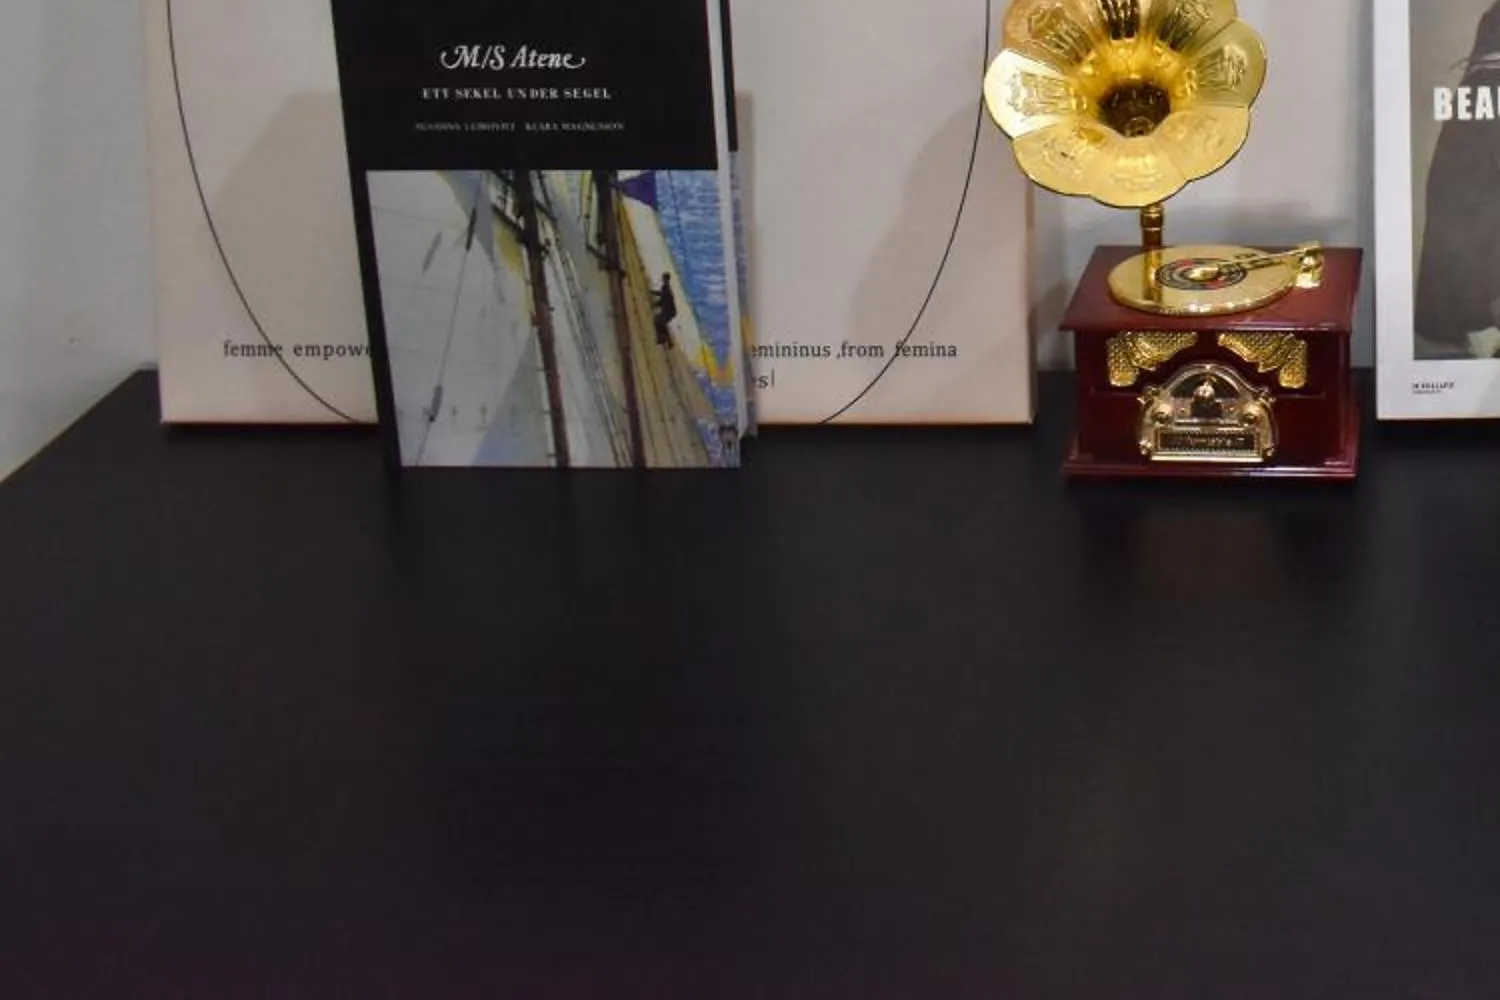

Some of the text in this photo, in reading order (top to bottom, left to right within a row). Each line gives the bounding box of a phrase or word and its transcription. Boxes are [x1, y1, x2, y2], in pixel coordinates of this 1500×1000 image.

[439, 45, 587, 70] M/S Atene
[507, 87, 559, 100] UNDER
[563, 87, 612, 100] SEGEL
[895, 340, 958, 357] femina
